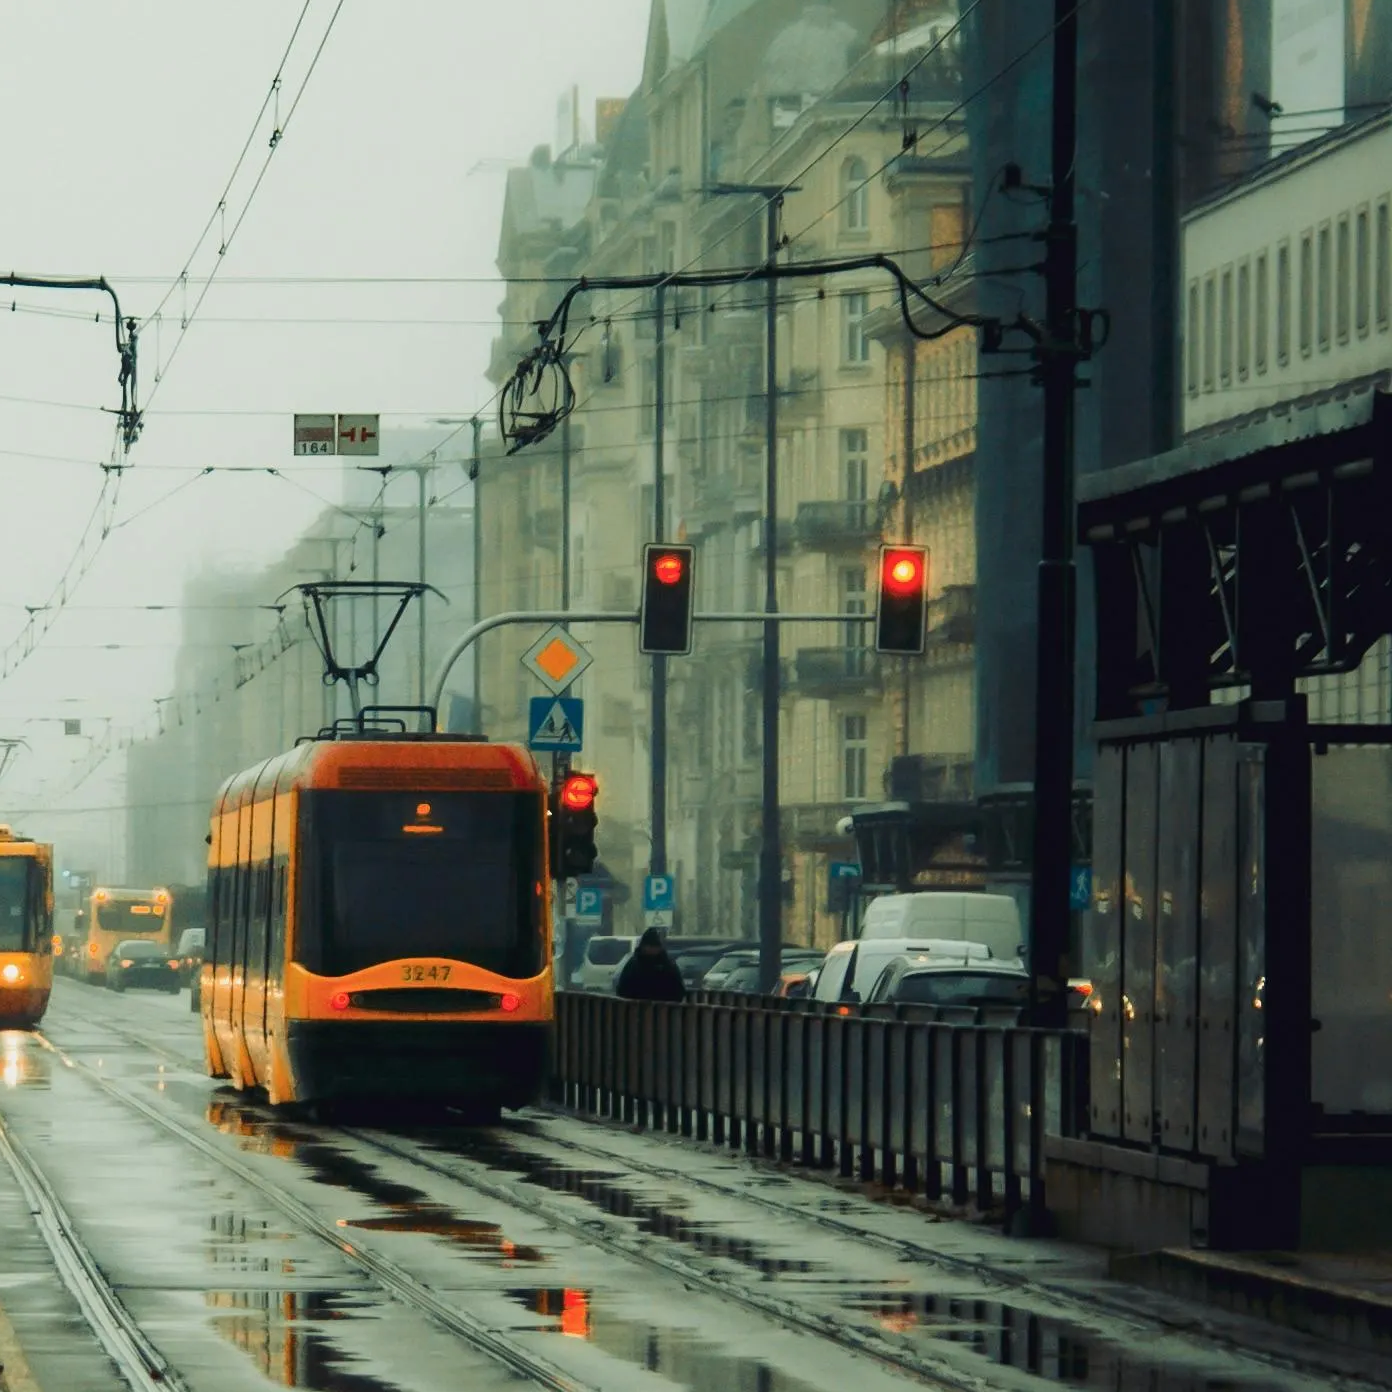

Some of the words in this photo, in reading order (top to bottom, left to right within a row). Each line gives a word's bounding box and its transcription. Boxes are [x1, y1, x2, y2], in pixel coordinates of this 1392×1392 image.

[301, 442, 328, 454] 164
[650, 877, 668, 901] P
[580, 890, 597, 912] P
